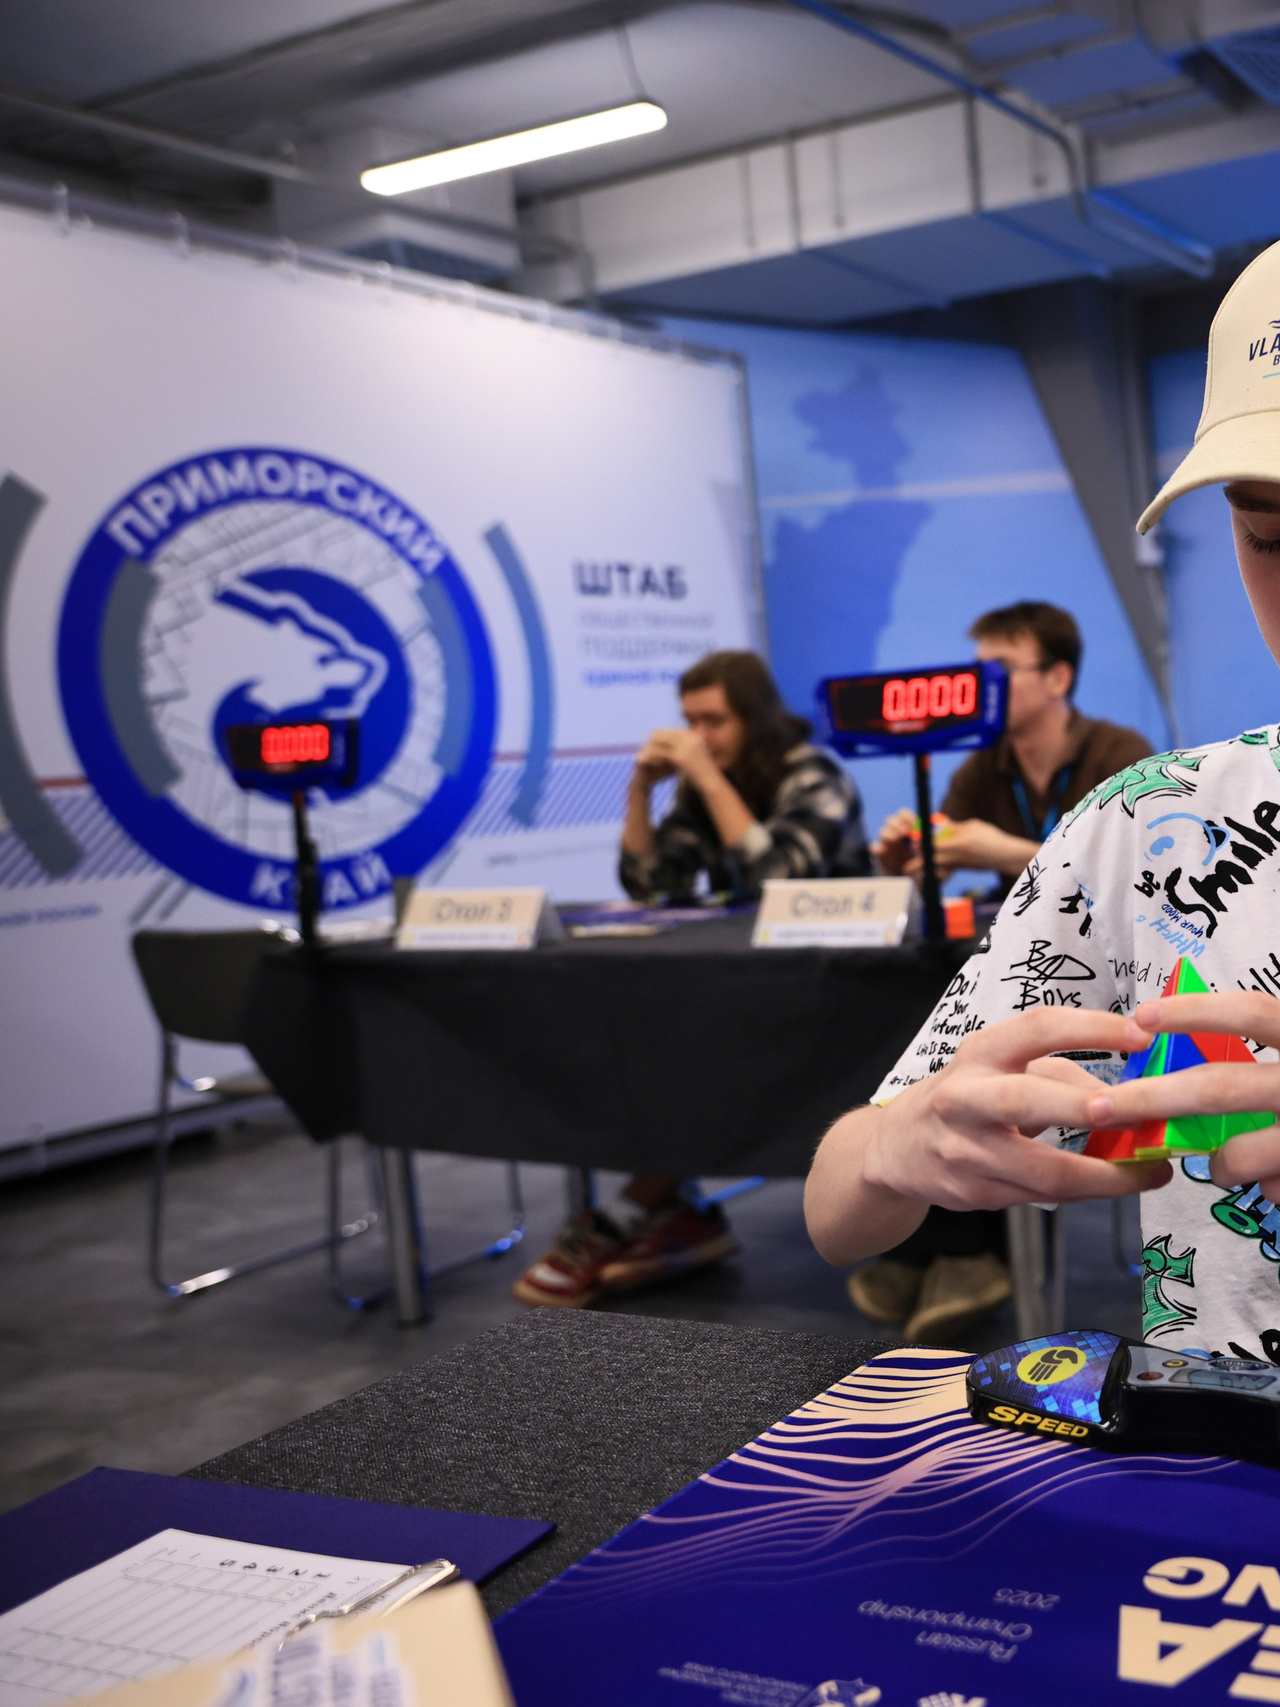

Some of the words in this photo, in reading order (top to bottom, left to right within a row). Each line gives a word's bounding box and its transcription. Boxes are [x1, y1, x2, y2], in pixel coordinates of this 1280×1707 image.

[106, 452, 448, 574] ПРИМОРСКИЙ
[573, 563, 688, 600] ШТАБ
[250, 853, 391, 904] КАЙ
[1134, 870, 1161, 898] be
[790, 893, 853, 918] Стол
[859, 891, 875, 914] 4
[1161, 903, 1181, 923] MOOD
[988, 1405, 1089, 1438] SPEED
[993, 1586, 1061, 1611] 2025
[857, 1599, 1033, 1641] Championship
[914, 1630, 1019, 1663] Russian
